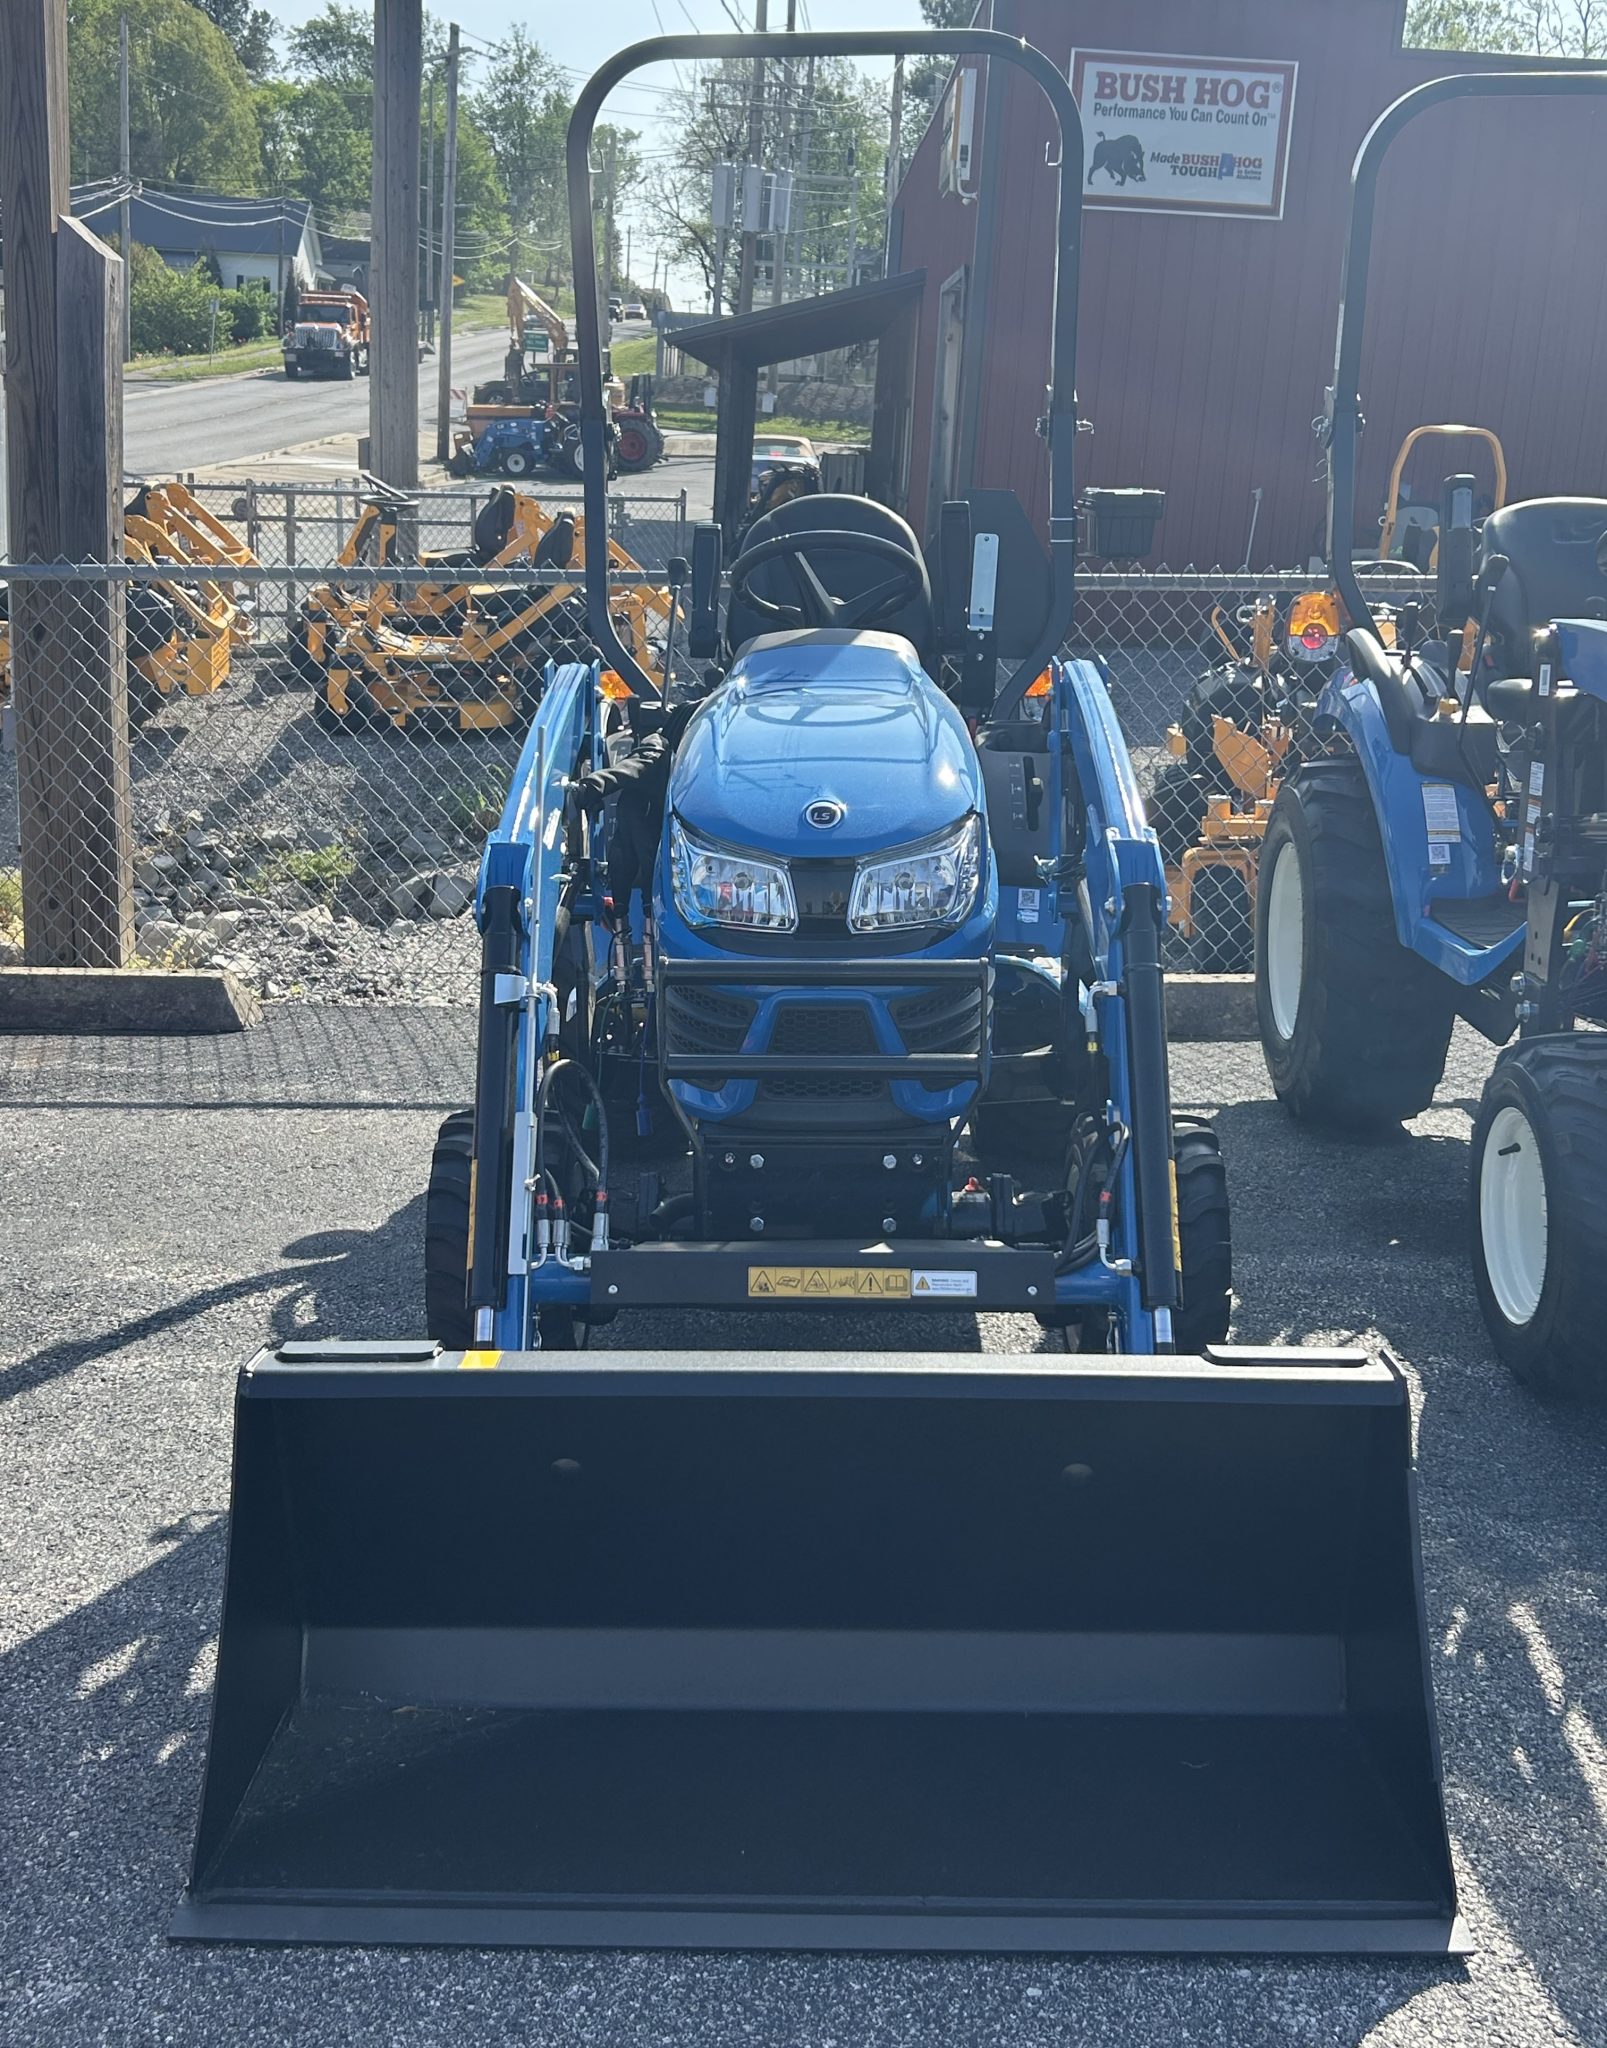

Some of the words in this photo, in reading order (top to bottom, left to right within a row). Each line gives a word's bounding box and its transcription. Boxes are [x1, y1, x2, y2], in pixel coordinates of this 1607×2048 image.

[1094, 71, 1187, 104] BUSH
[1093, 102, 1166, 120] Performance
[1169, 106, 1188, 121] You
[1191, 108, 1213, 123] Can
[1216, 109, 1249, 125] Count
[1150, 152, 1181, 164] Made
[1181, 154, 1220, 166] BUSH
[1233, 156, 1263, 169] HOG
[1170, 165, 1218, 178] TOUGH
[813, 812, 831, 821] LS
